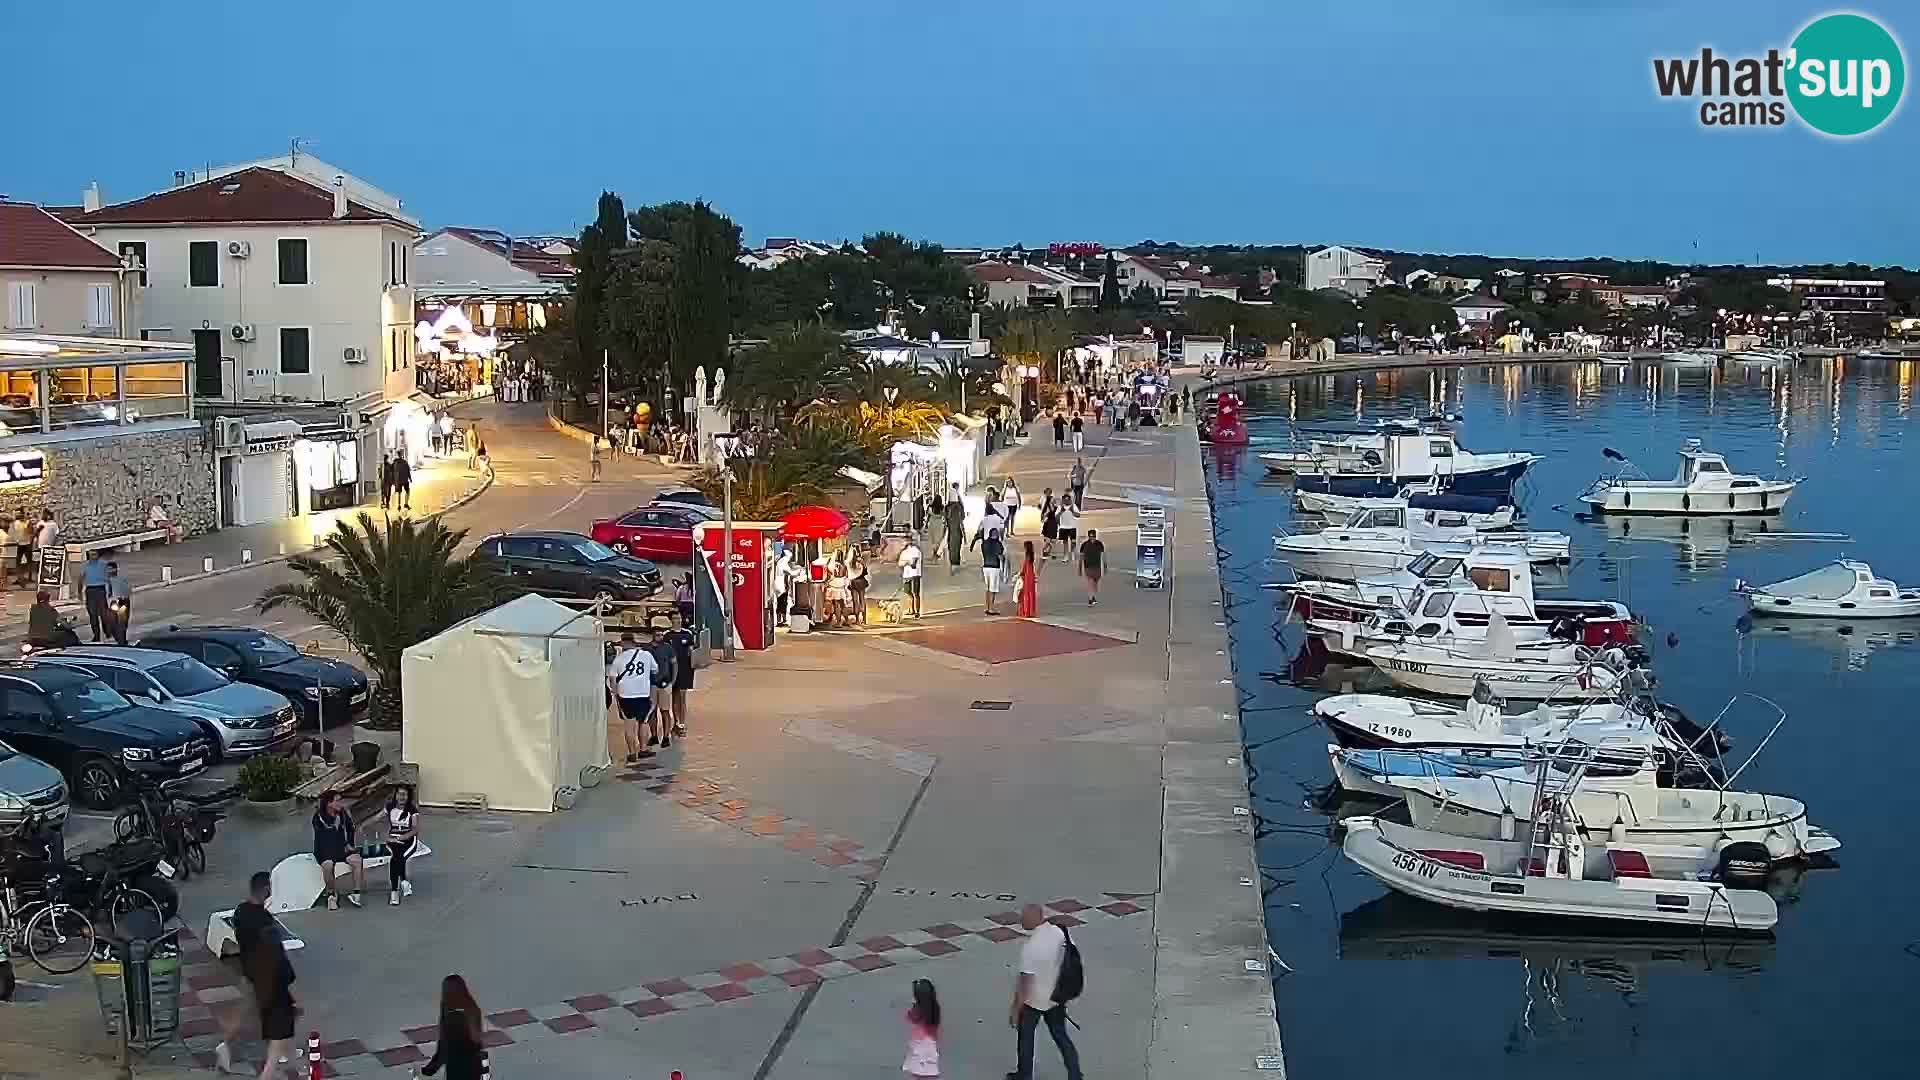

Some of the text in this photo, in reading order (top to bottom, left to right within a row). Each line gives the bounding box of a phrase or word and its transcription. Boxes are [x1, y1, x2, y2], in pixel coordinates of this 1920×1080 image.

[626, 661, 645, 676] 98
[1368, 722, 1412, 738] IZ 1980
[1392, 853, 1440, 879] 456 NV
